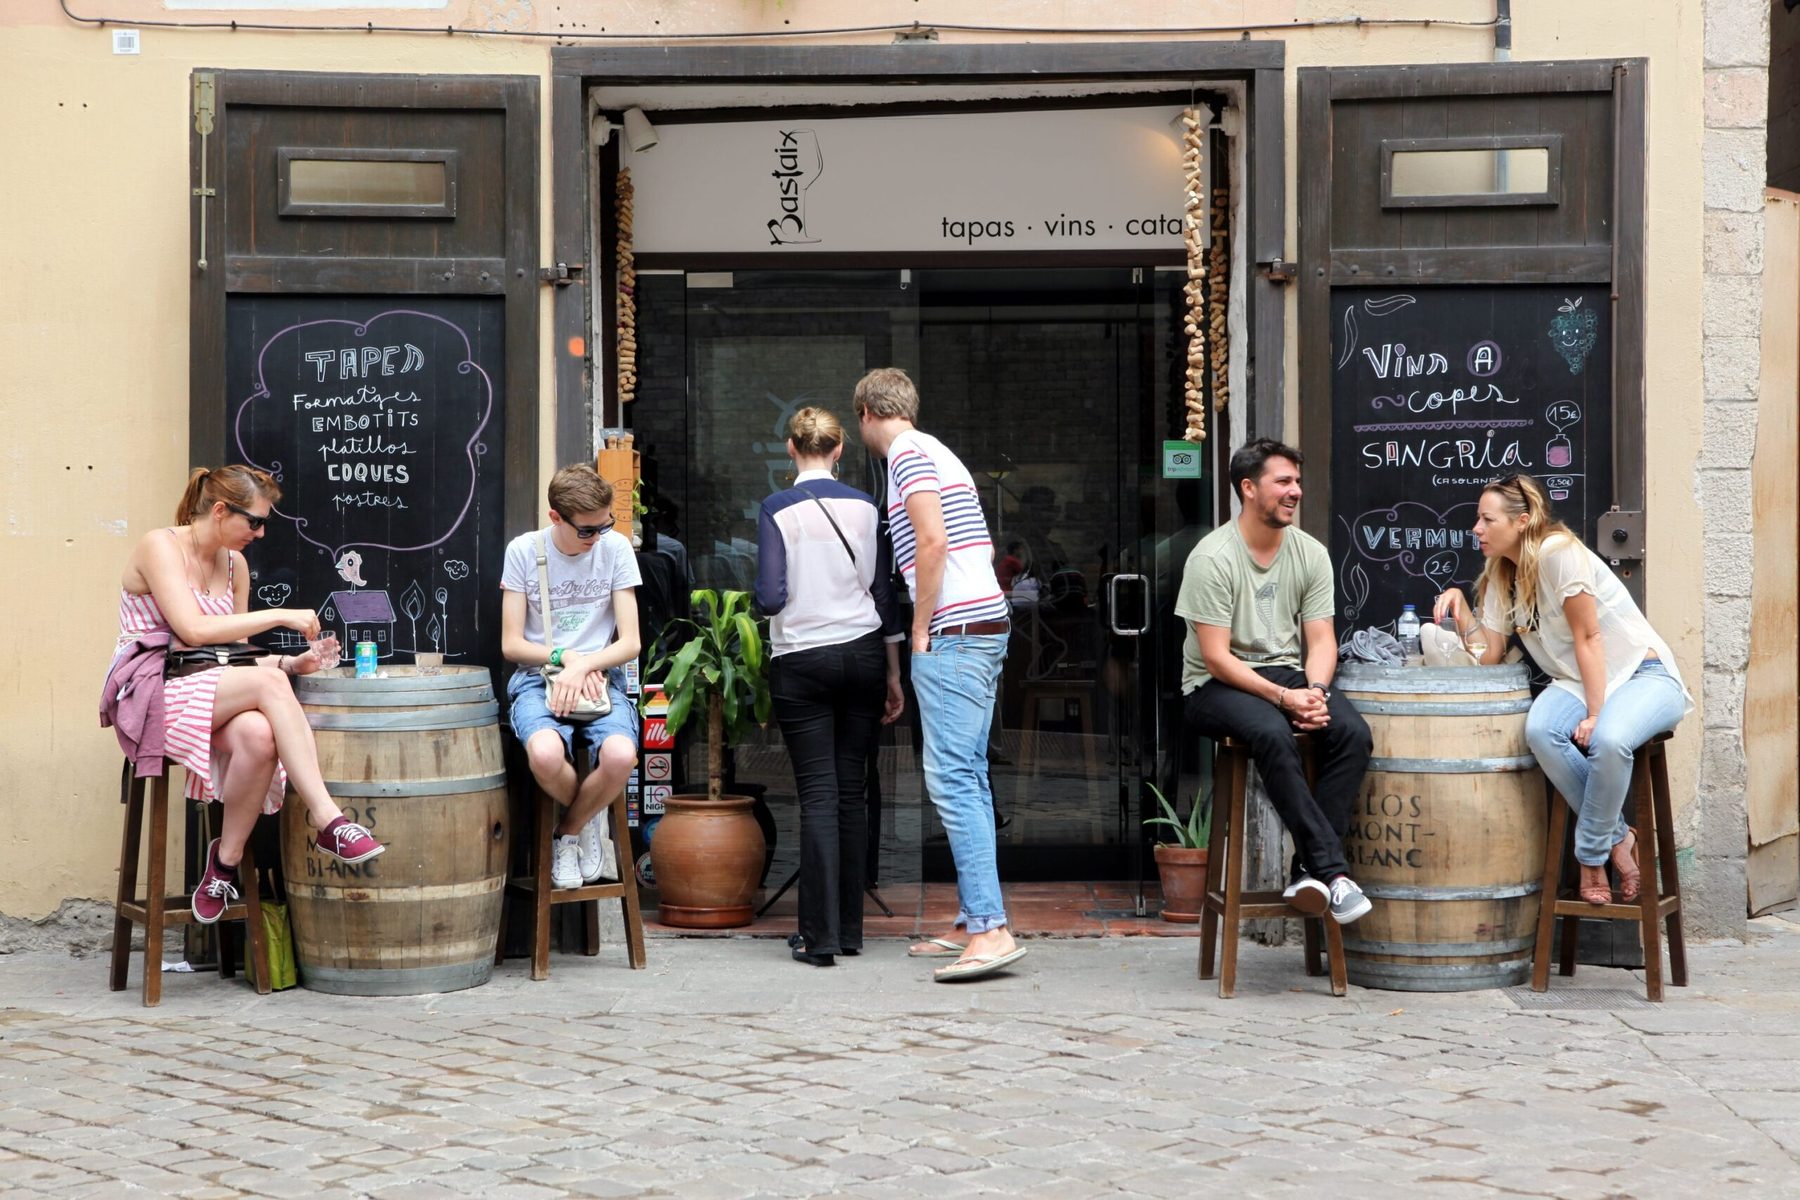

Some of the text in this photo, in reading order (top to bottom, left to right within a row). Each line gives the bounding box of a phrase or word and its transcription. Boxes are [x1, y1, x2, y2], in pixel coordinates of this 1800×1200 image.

[767, 129, 804, 246] Bastaix
[942, 213, 1184, 246] tapas vins cata
[1474, 346, 1494, 373] A
[1408, 383, 1520, 415] copes
[1548, 405, 1578, 421] 15€
[318, 435, 417, 462] platillos
[328, 463, 410, 484] COQUES
[332, 491, 409, 512] postres
[1362, 525, 1481, 551] VERMUT
[1429, 560, 1453, 575] 2€
[645, 723, 670, 745] illy
[305, 806, 377, 829] COS
[646, 803, 666, 811] NIGH
[1354, 793, 1422, 818] LOS
